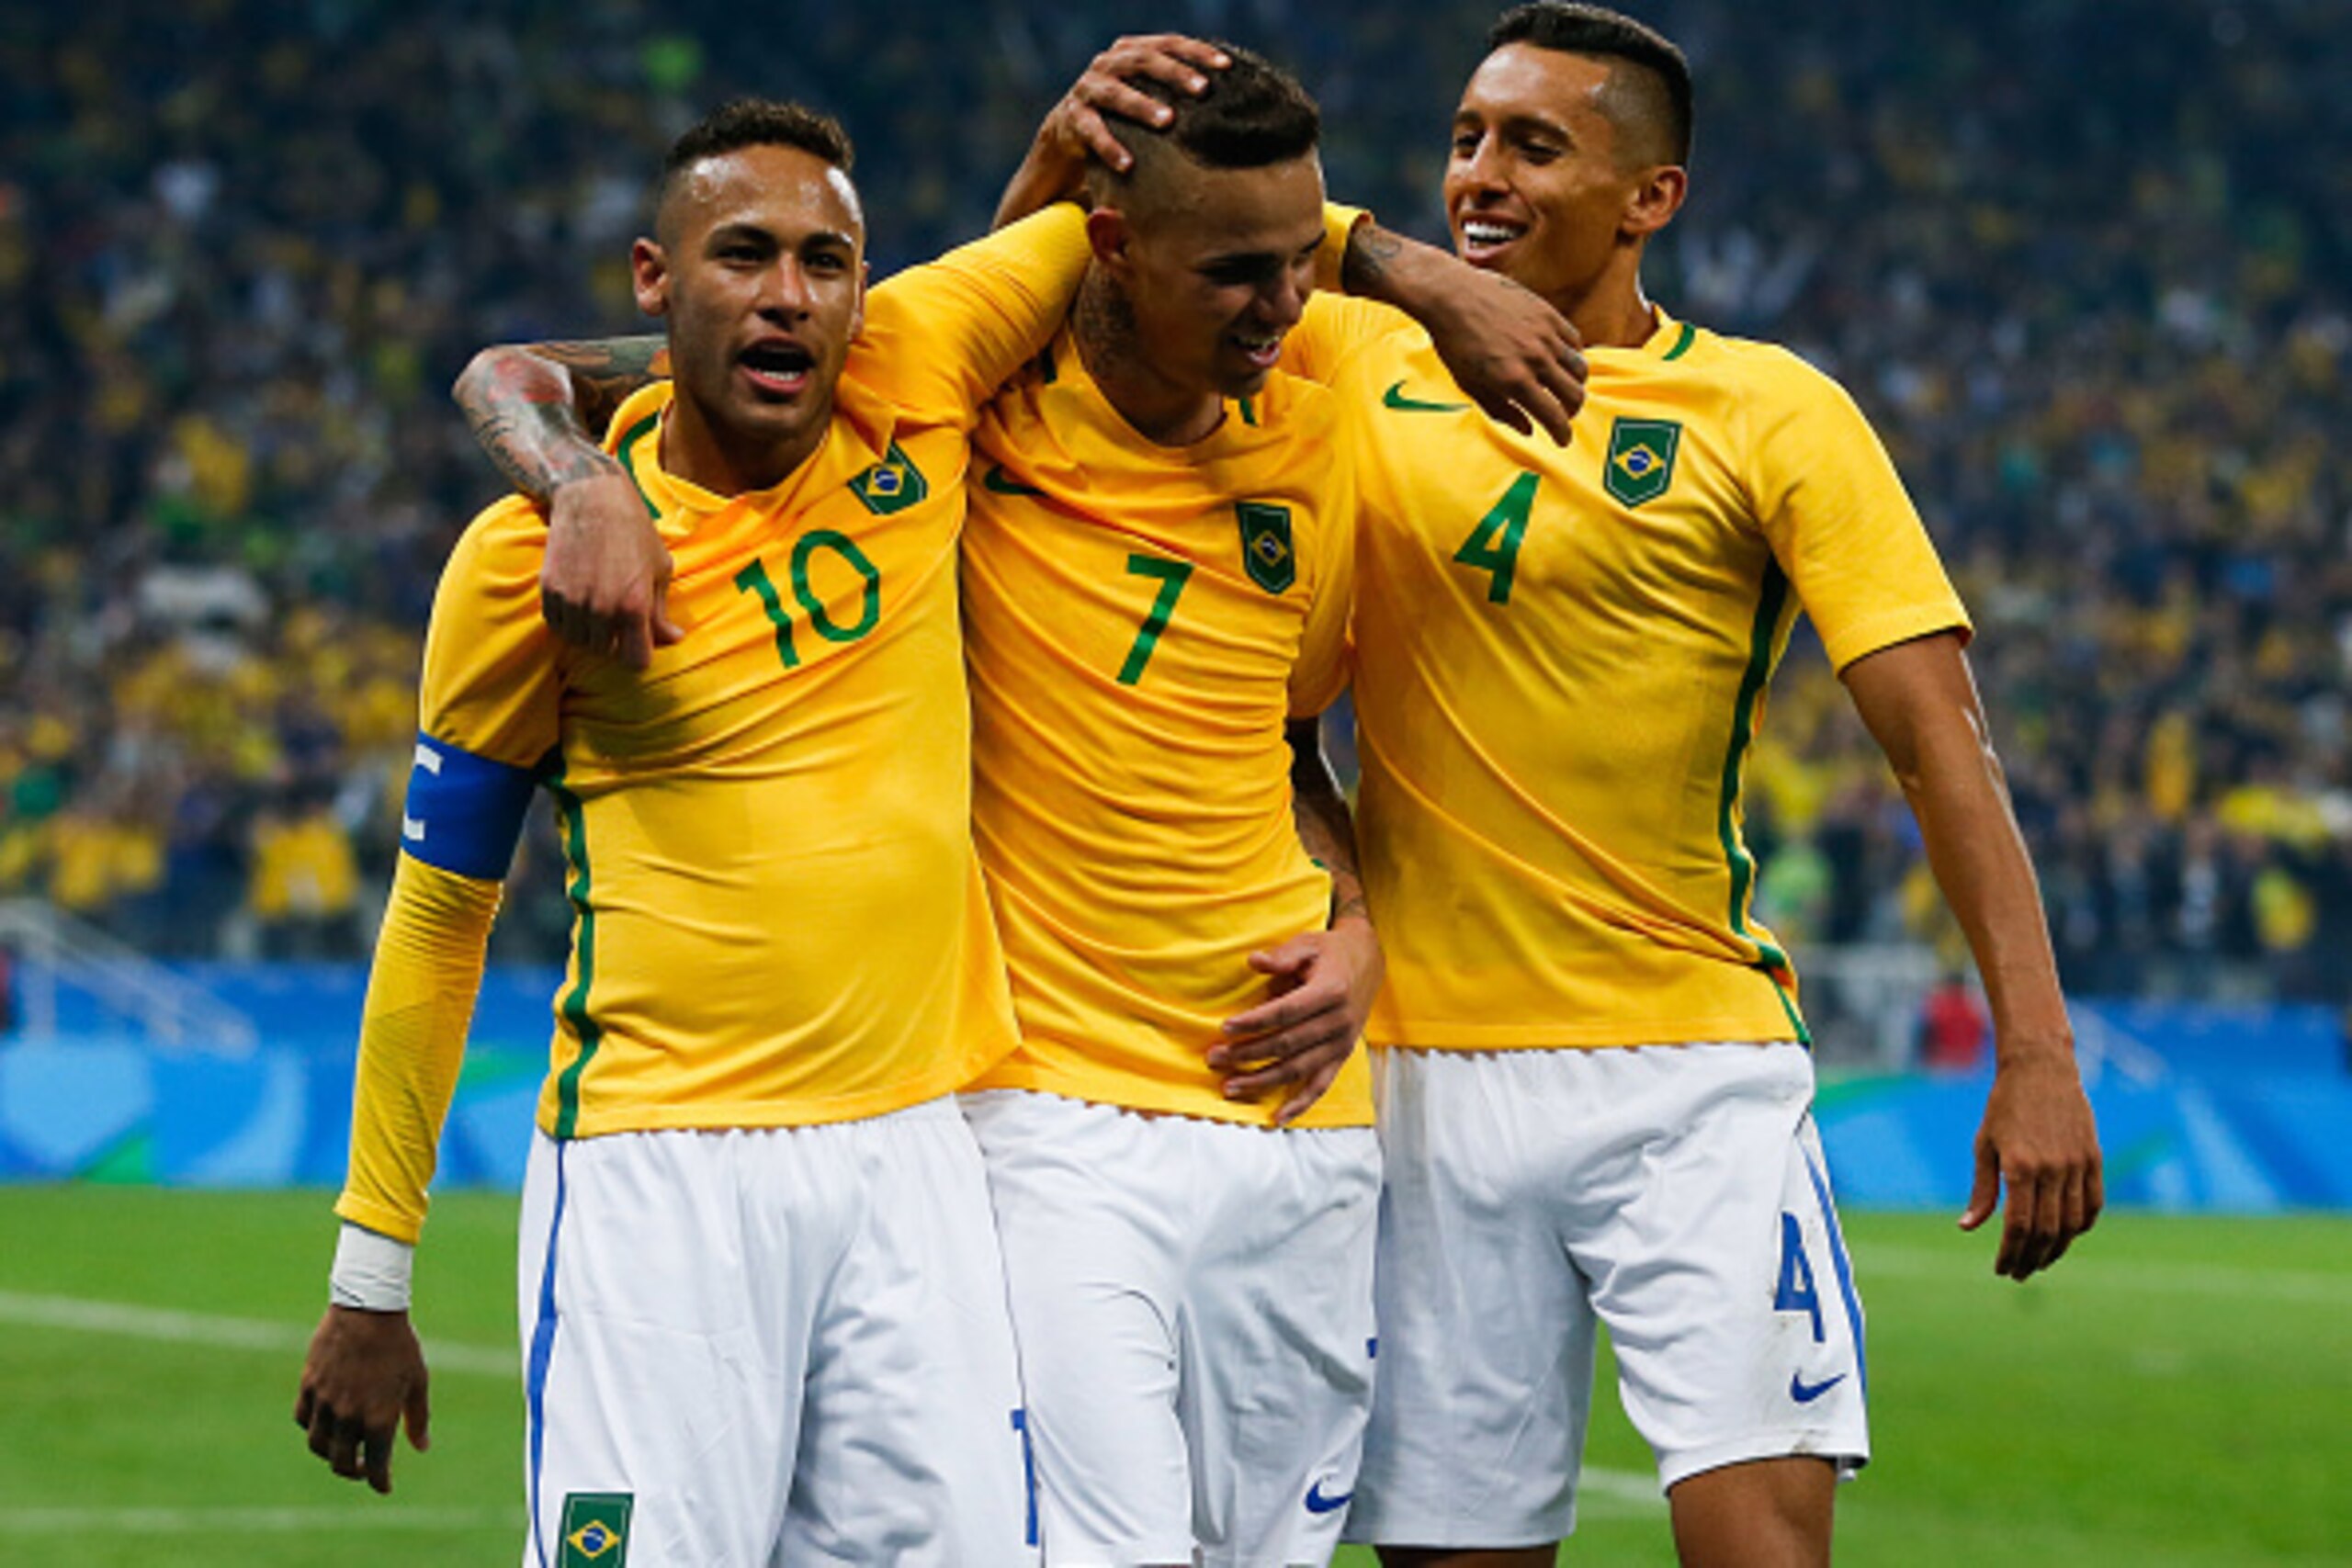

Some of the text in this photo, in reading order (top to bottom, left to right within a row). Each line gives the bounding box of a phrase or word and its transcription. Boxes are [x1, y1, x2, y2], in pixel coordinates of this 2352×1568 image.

[734, 530, 879, 669] 10
[1453, 470, 1542, 605] 4
[1116, 554, 1194, 685] 7
[1773, 1211, 1826, 1341] 4
